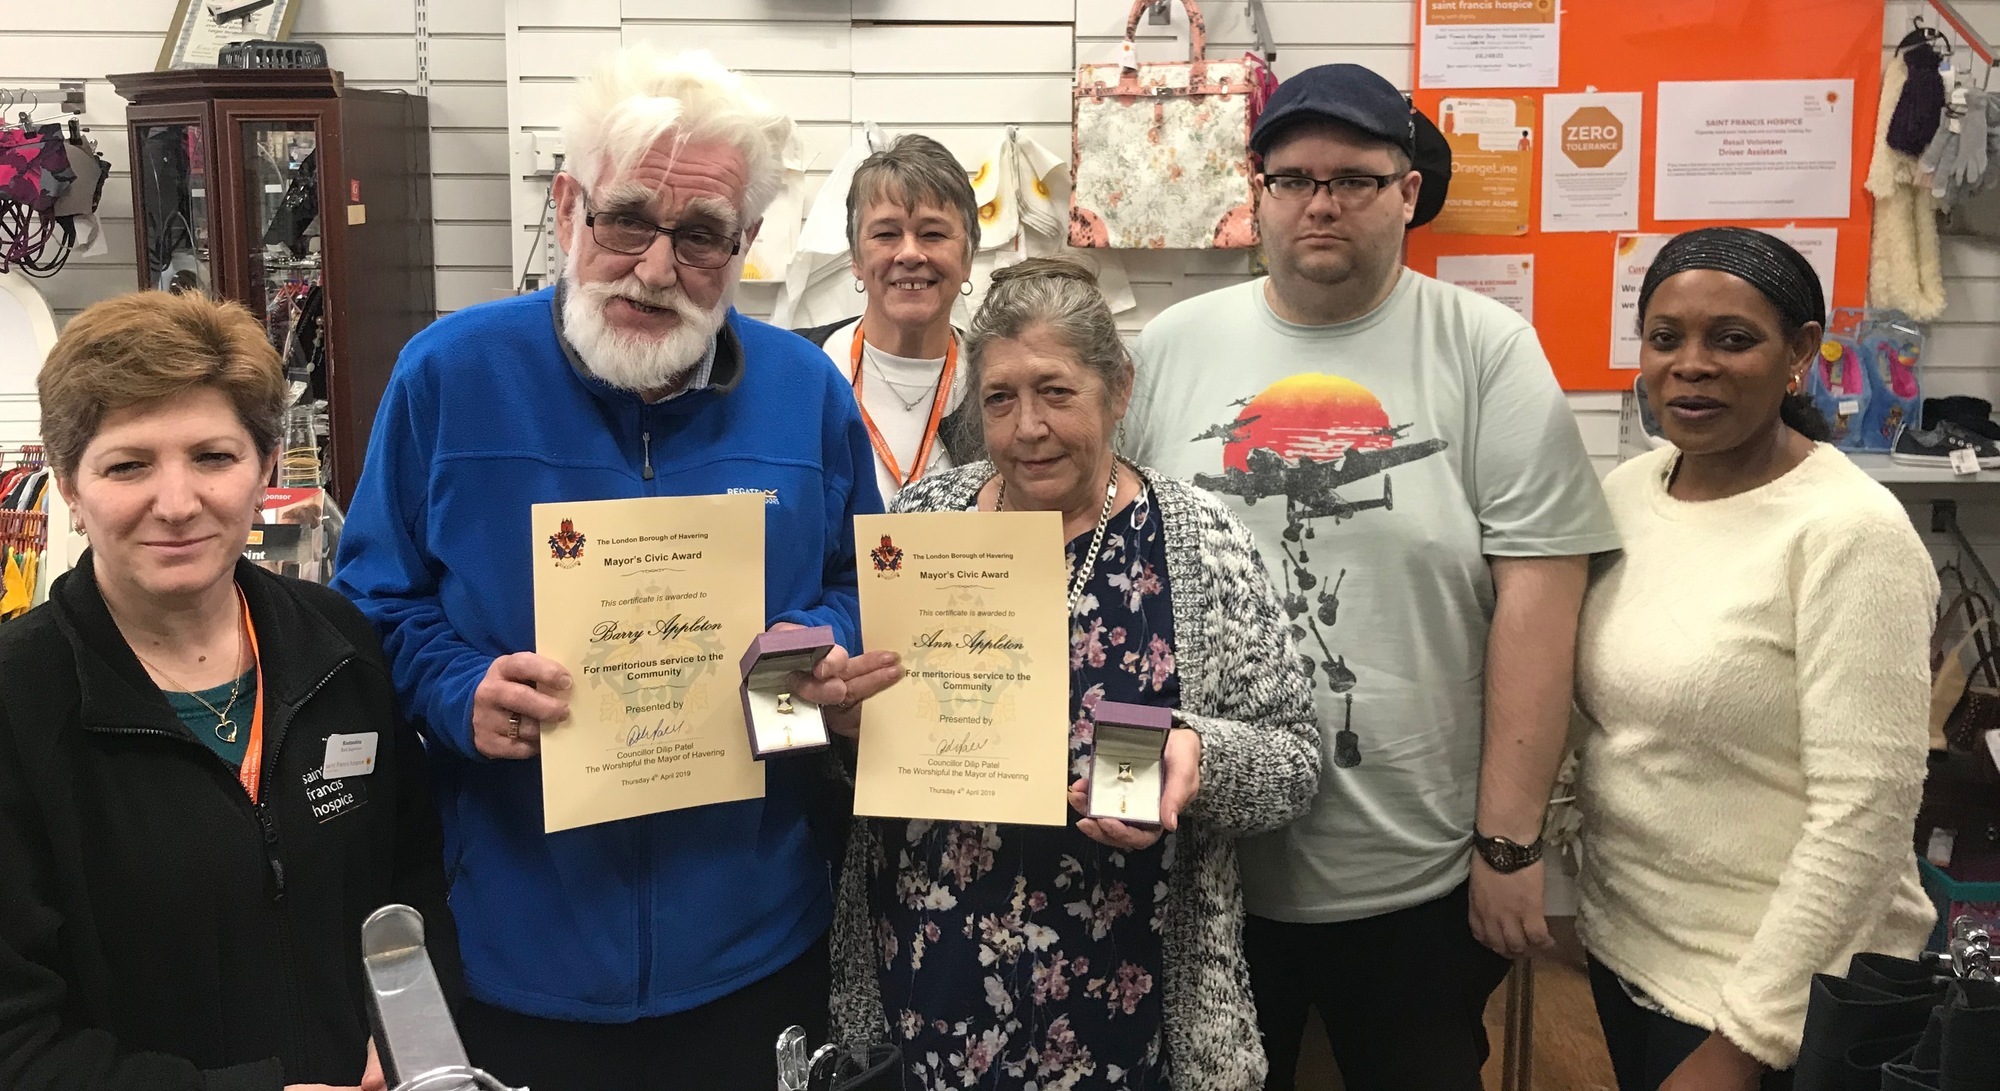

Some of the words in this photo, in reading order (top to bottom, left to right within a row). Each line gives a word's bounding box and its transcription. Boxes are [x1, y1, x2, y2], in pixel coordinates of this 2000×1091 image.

[1431, 0, 1456, 10] saint
[1459, 0, 1493, 10] francis
[1495, 0, 1533, 11] hospice
[1705, 119, 1728, 127] SAINT
[1767, 118, 1803, 126] HOSPICE
[1567, 125, 1617, 140] ZERO
[1566, 142, 1618, 151] TOLERANCE
[1723, 138, 1745, 146] Retail
[1746, 138, 1783, 146] Volunteer
[1718, 148, 1744, 156] Driver
[1747, 148, 1787, 156] Assistants
[1451, 161, 1518, 176] OrangeLine
[1621, 284, 1636, 293] We
[264, 493, 292, 501] ponsor
[611, 537, 638, 545] London
[639, 534, 669, 543] Borough
[678, 532, 708, 540] Havering
[603, 555, 642, 567] Mayor's
[644, 553, 669, 562] Civic
[671, 551, 702, 560] Award
[951, 552, 978, 560] Borough
[986, 552, 1014, 560] Havering
[920, 571, 955, 581] Mayor's
[957, 570, 979, 579] Civic
[981, 570, 1009, 579] Award
[601, 599, 617, 607] This
[618, 596, 655, 606] certificate
[664, 592, 698, 601] awarded
[699, 591, 708, 599] to
[919, 609, 934, 617] This
[934, 609, 968, 617] certificate
[969, 609, 976, 617] is
[977, 609, 1007, 617] awarded
[589, 620, 645, 644] Barry
[647, 613, 723, 641] Appleton
[913, 629, 953, 648] Ann
[956, 630, 1024, 655] Appleton
[583, 666, 601, 675] For
[602, 660, 658, 673] meritorious
[660, 656, 695, 666] service
[696, 654, 707, 662] to
[708, 653, 724, 661] the
[627, 668, 682, 681] Community
[905, 669, 921, 678] For
[922, 671, 971, 680] meritorious
[972, 671, 1004, 680] service
[1017, 672, 1031, 681] the
[943, 681, 992, 692] Community
[625, 701, 671, 714] Presented
[673, 700, 684, 710] by
[939, 714, 981, 724] Presented
[982, 716, 994, 726] by
[616, 748, 655, 759] Councillor
[656, 745, 673, 755] Dilip
[674, 742, 694, 752] Patel
[585, 765, 601, 774] The
[602, 759, 642, 771] Worshipful
[643, 756, 656, 765] the
[657, 754, 681, 763] Mayor
[682, 752, 690, 760] of
[691, 748, 726, 759] Havering
[927, 758, 963, 768] Councillor
[964, 760, 980, 769] Dilip
[981, 760, 1000, 769] Patel
[621, 777, 650, 787] Thursday
[660, 772, 675, 781] April
[675, 770, 692, 778] 2019
[898, 766, 912, 775] The
[913, 767, 951, 777] Worshipful
[951, 768, 963, 777] the
[964, 769, 987, 779] Mayor
[988, 770, 996, 778] of
[997, 771, 1029, 781] Havering
[306, 779, 344, 801] francis
[929, 786, 956, 795] Thursday
[966, 788, 980, 796] April
[311, 792, 355, 817] hospice
